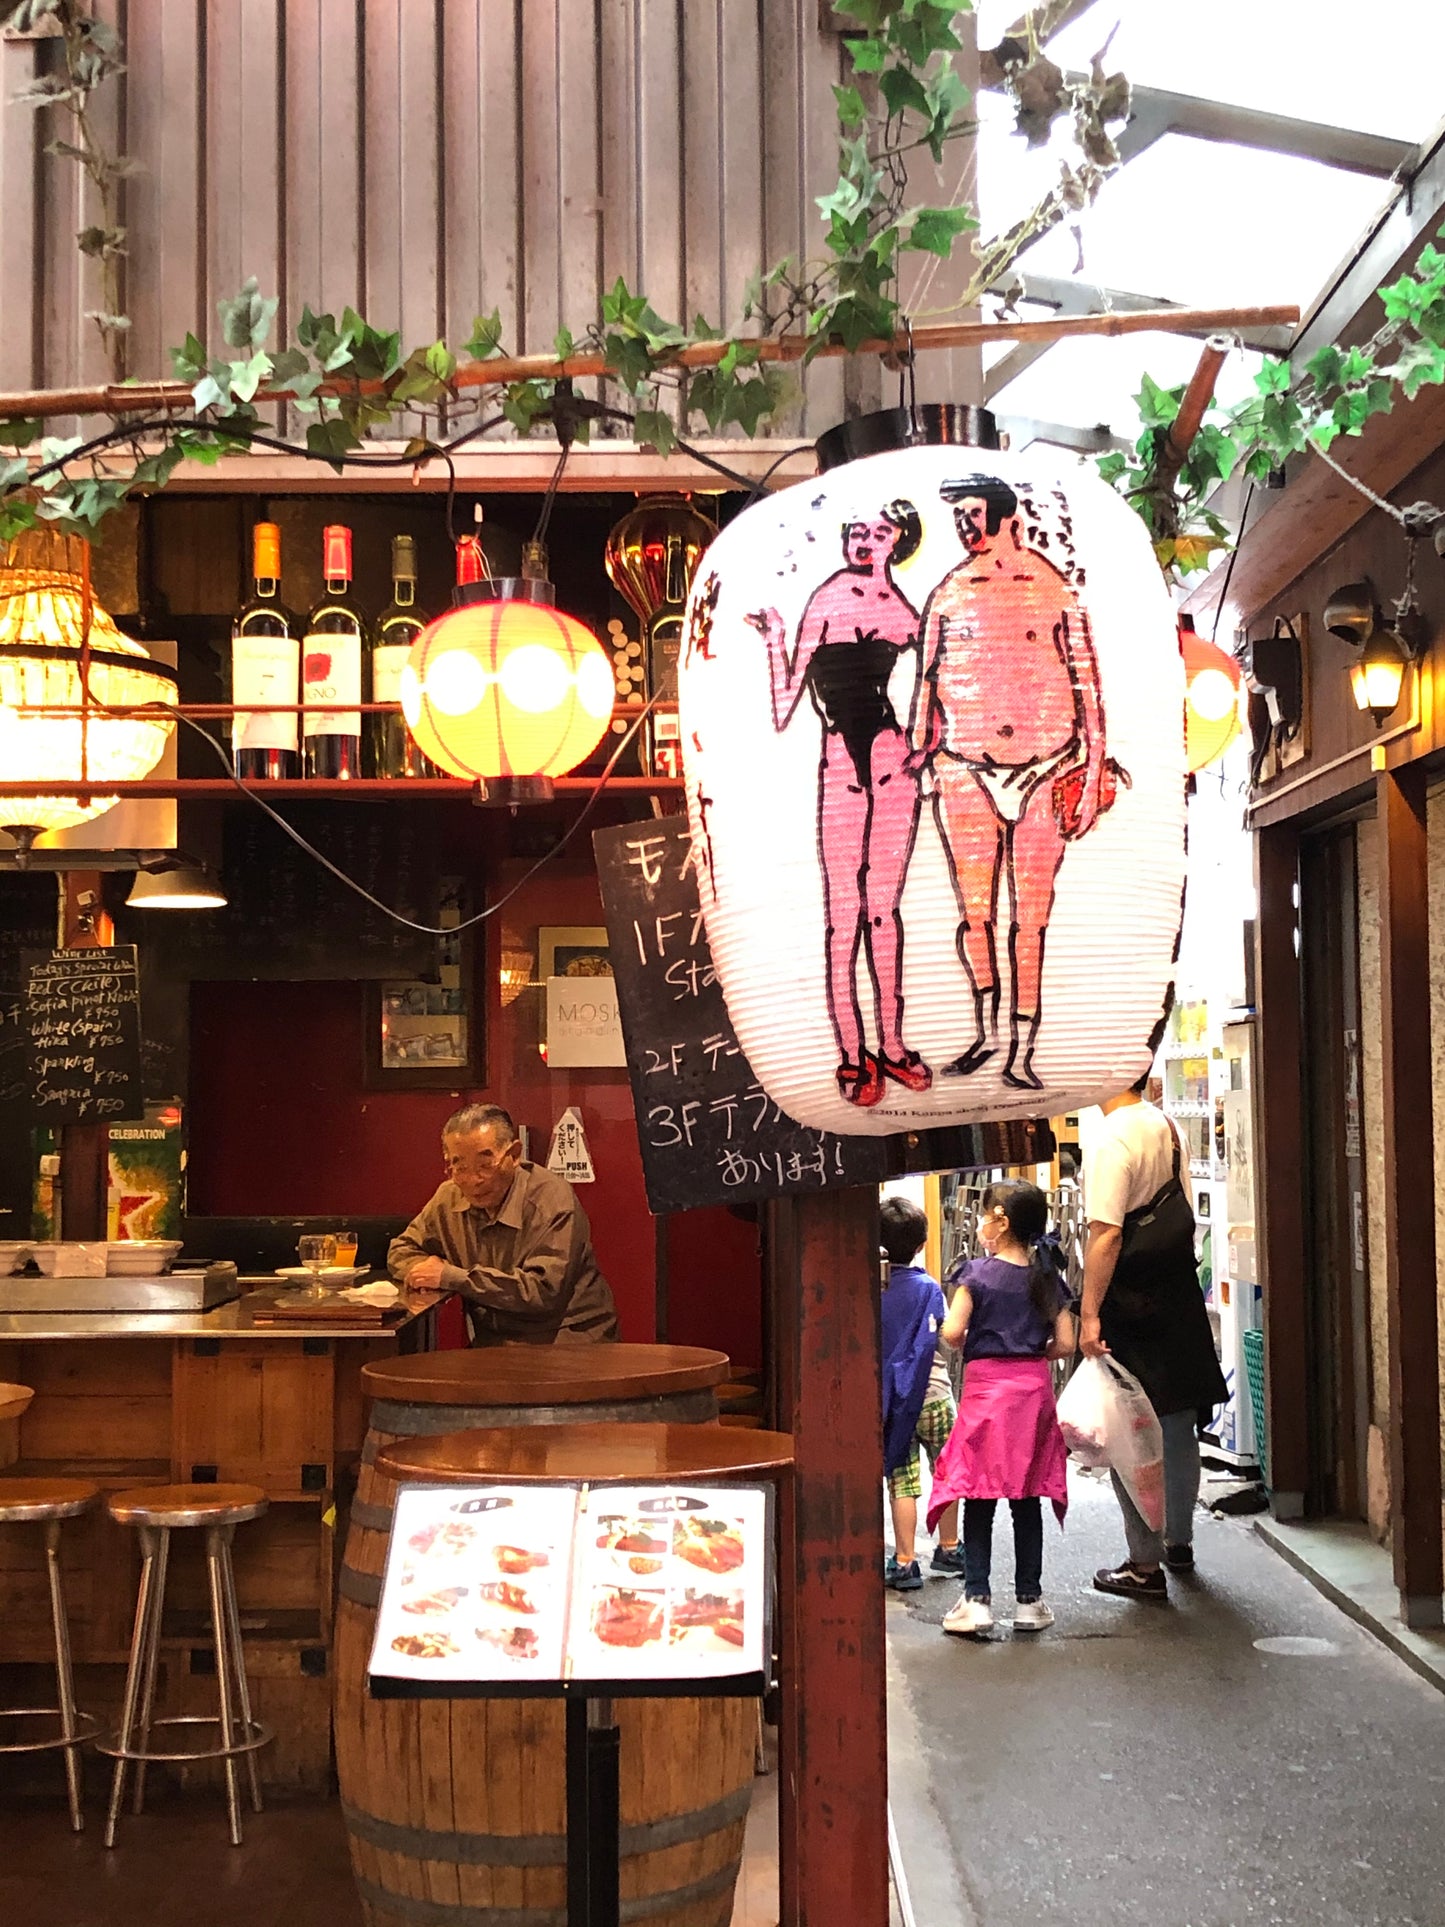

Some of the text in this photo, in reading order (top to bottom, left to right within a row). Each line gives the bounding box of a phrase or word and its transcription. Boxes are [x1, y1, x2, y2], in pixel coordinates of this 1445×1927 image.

[86, 949, 107, 958] List
[30, 998, 68, 1016] Sofia
[645, 1043, 686, 1077] 2F
[108, 1128, 166, 1140] CELEBRATION
[566, 1161, 588, 1171] PUSH
